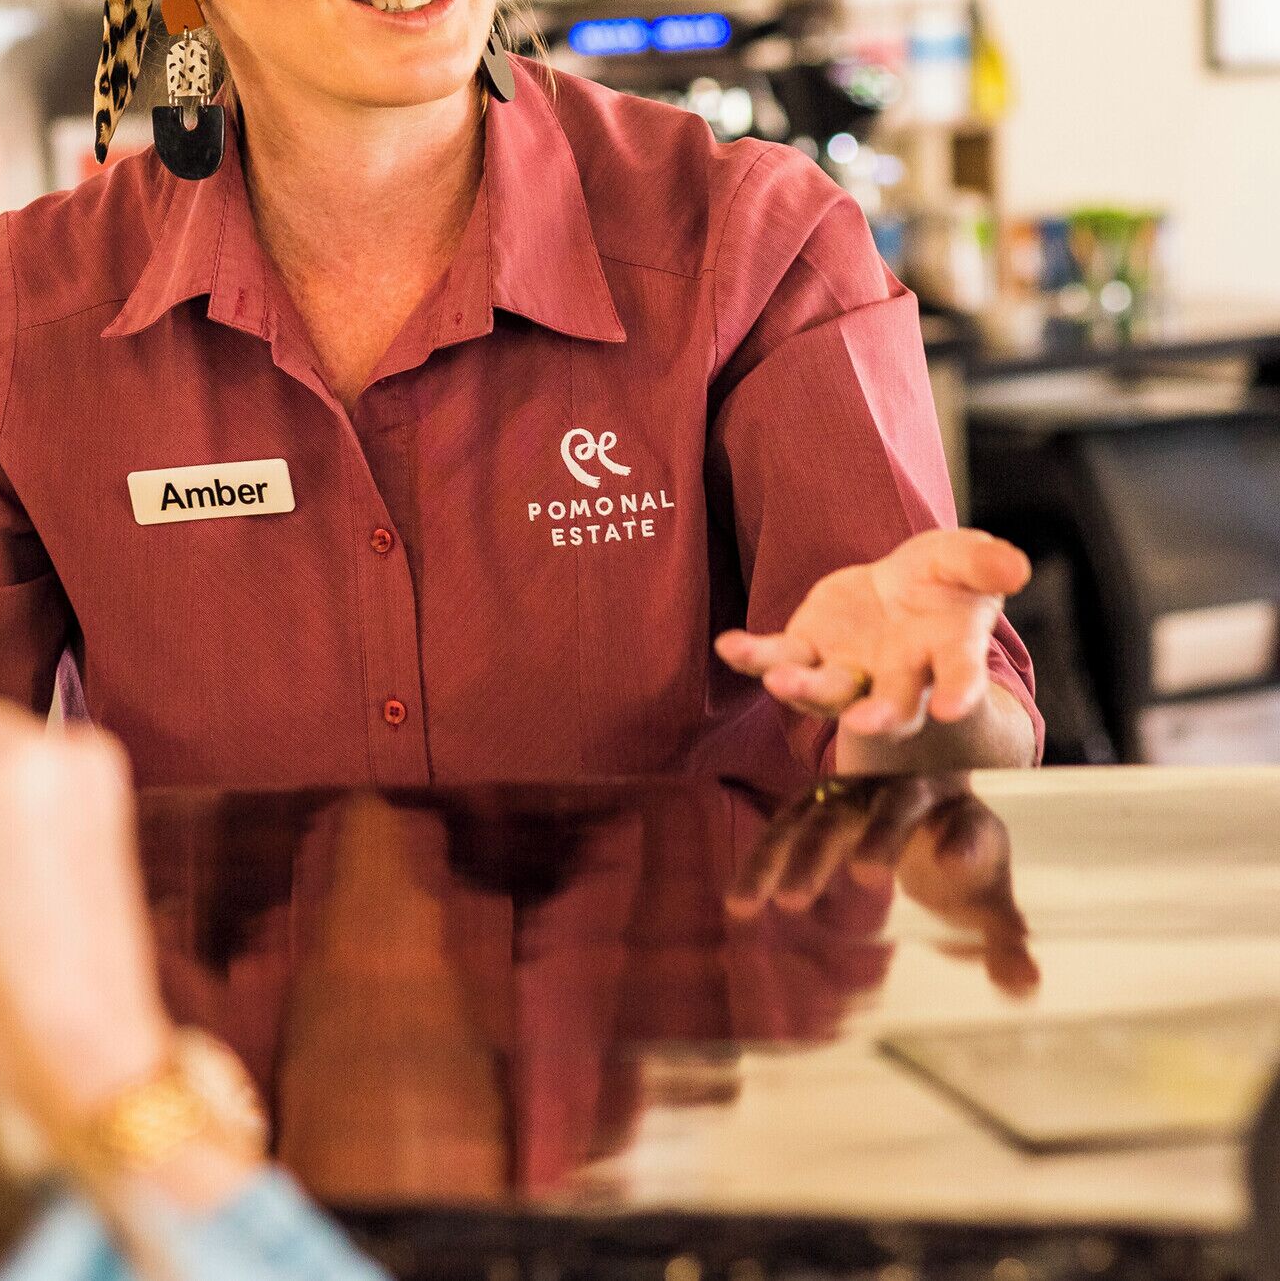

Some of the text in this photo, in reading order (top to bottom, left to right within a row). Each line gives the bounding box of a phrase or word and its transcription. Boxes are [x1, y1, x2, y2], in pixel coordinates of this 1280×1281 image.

[160, 478, 268, 511] Amber
[527, 489, 675, 522] POMONAL
[551, 518, 656, 547] ESTATE
